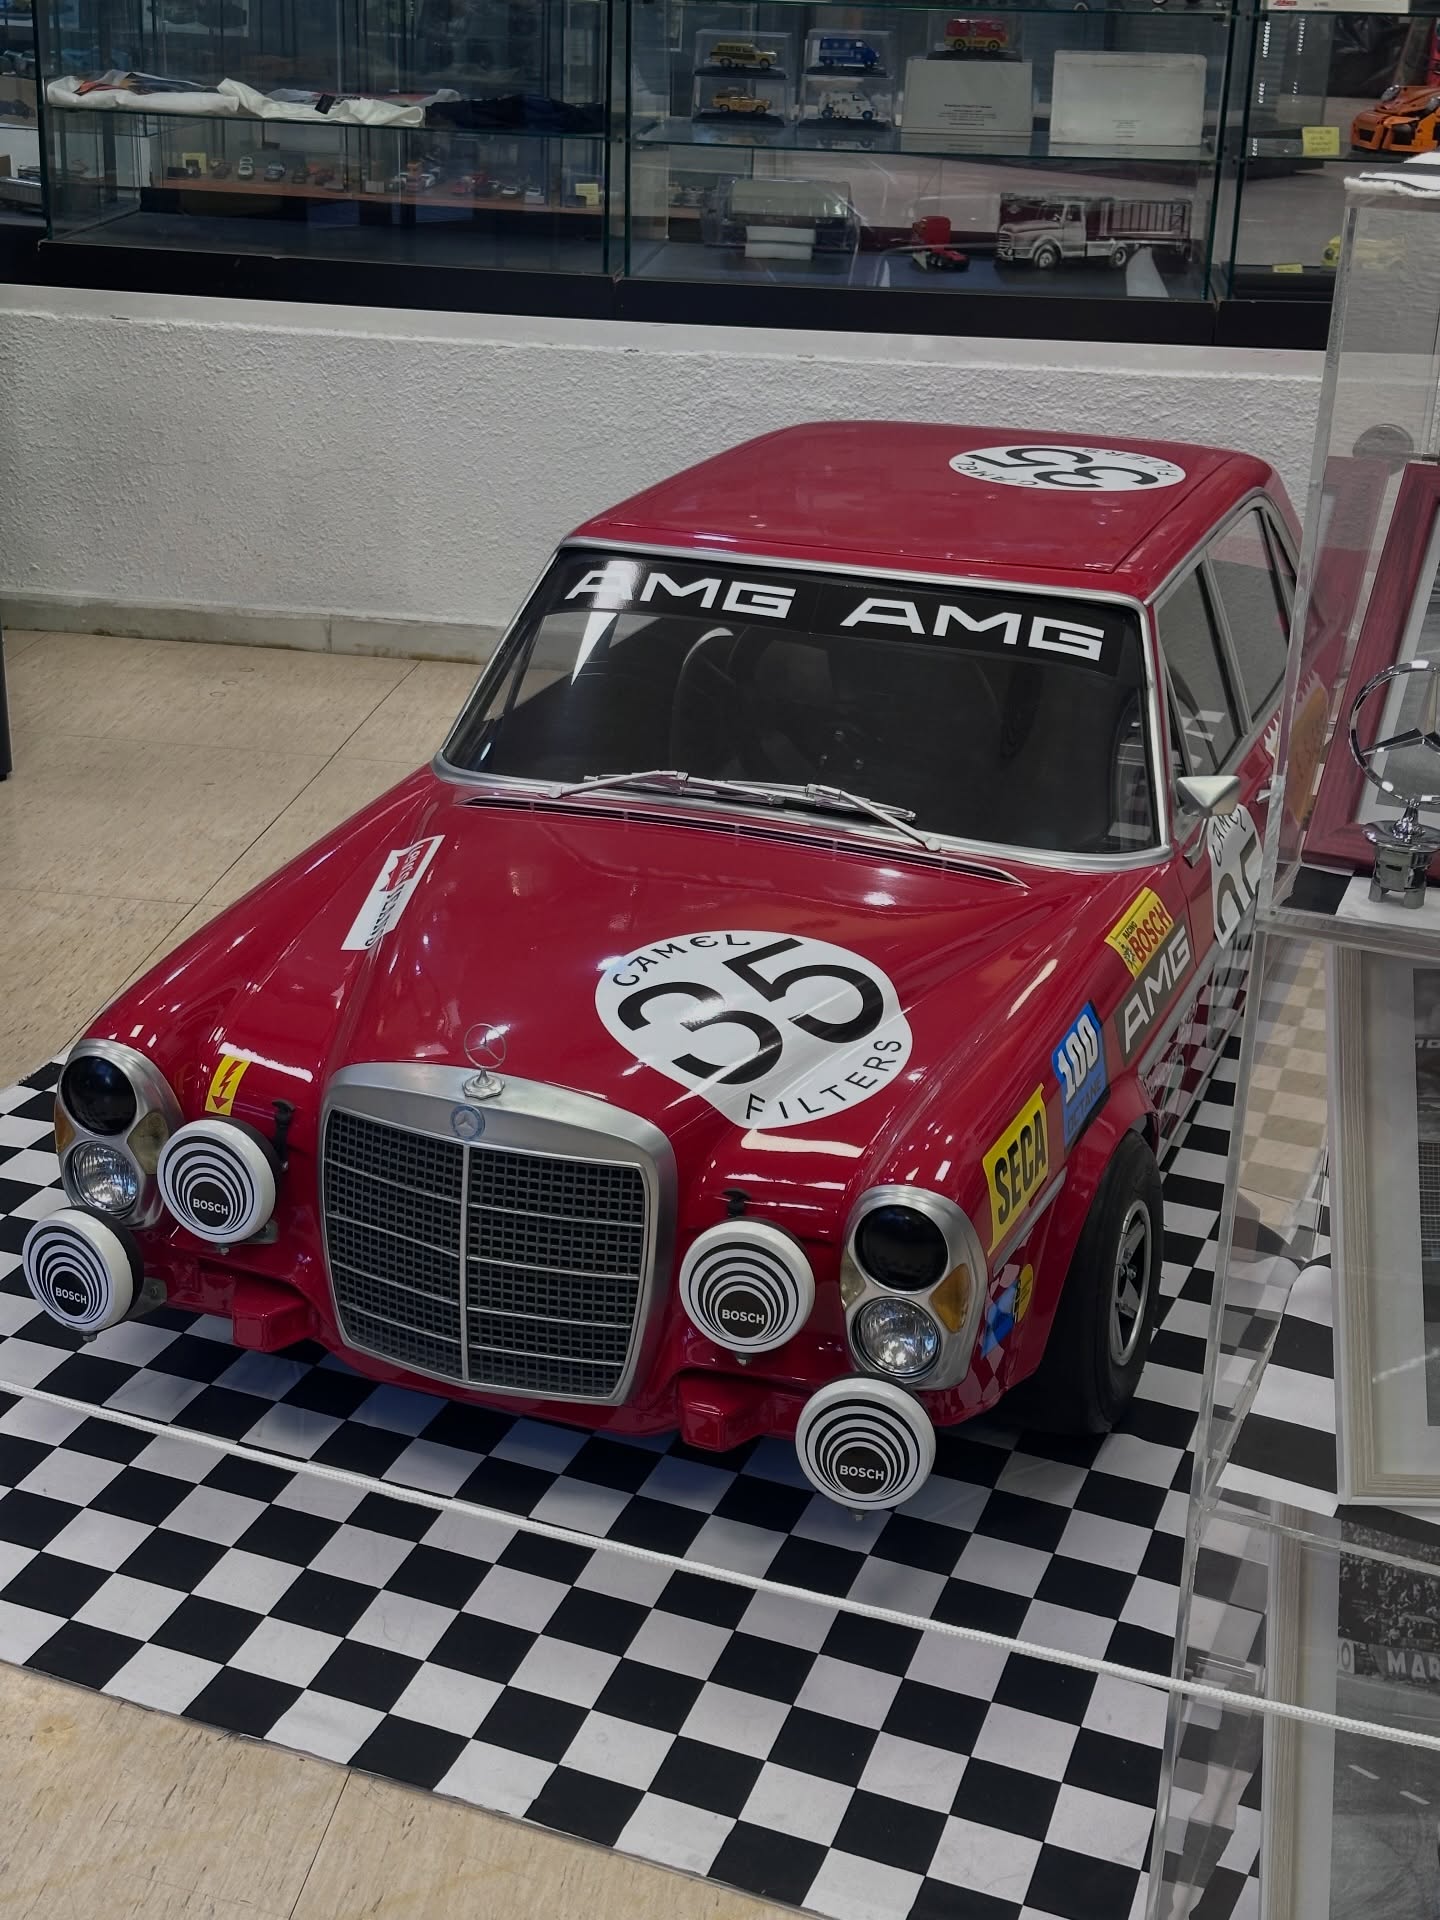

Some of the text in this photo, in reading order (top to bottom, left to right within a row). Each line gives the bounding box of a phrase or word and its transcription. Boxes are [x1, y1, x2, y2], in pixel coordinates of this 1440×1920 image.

[964, 447, 1159, 489] 35
[564, 570, 1105, 662] AMG AMG
[612, 933, 752, 987] CAMEL
[1128, 901, 1172, 964] BOSCH
[617, 937, 885, 1086] 35
[1124, 925, 1191, 1054] AMG
[745, 1039, 902, 1120] FILTERS
[1057, 1013, 1099, 1105] 100
[1067, 1073, 1103, 1135] OCTANE
[192, 1198, 229, 1215] BOSCH
[55, 1286, 87, 1305] BOSCH
[721, 1309, 766, 1325] BOSCH
[839, 1464, 885, 1481] BOSCH
